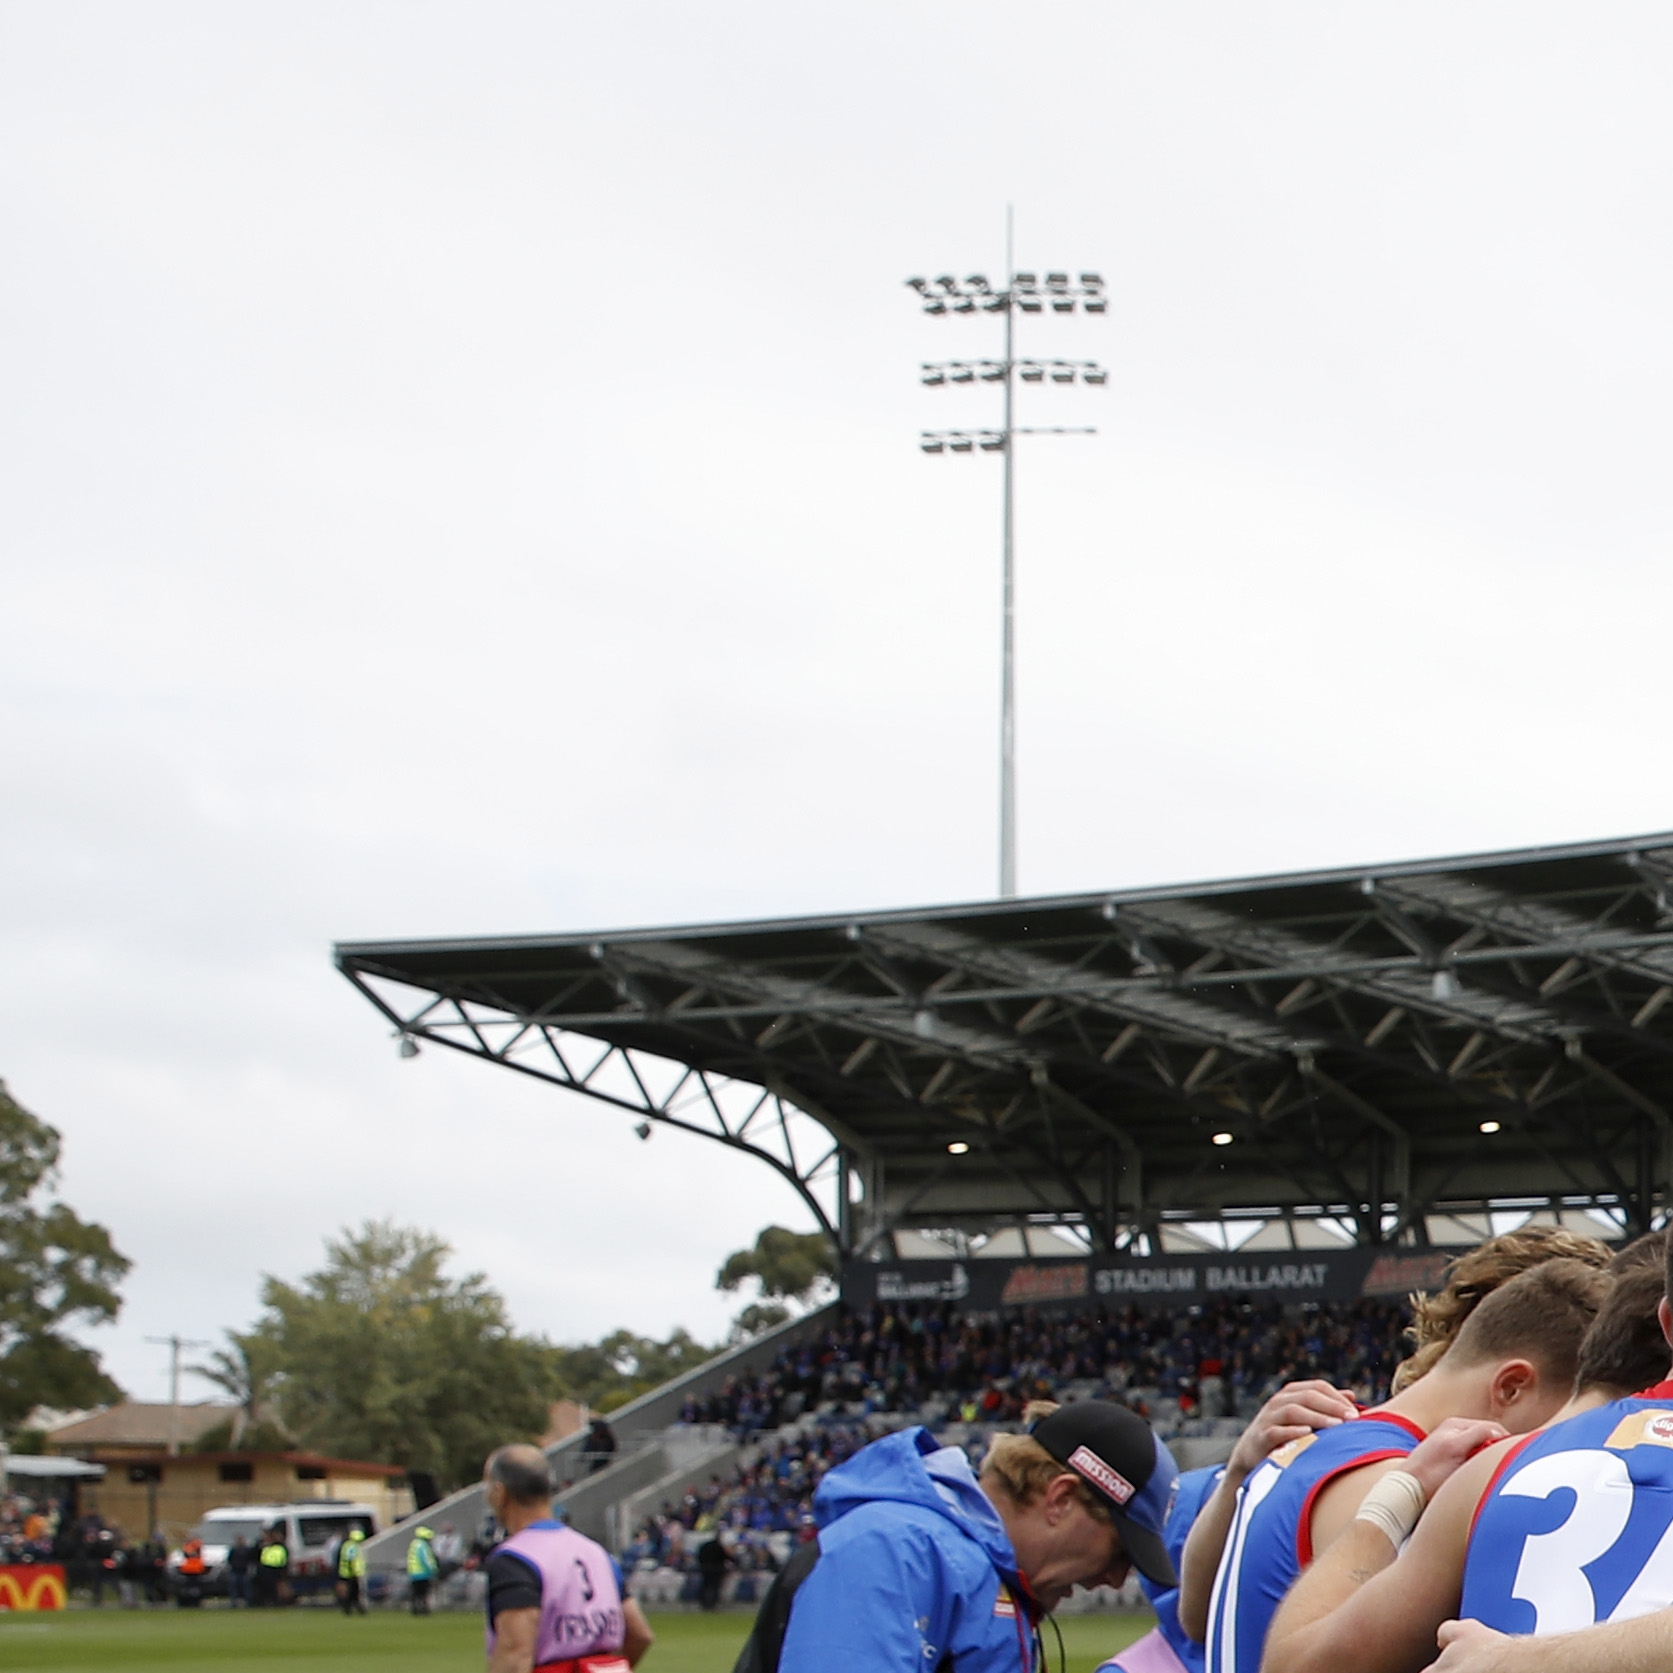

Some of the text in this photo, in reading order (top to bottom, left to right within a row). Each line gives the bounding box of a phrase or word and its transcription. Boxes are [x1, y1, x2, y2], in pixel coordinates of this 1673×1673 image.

[1095, 1267, 1196, 1293] STADIUM
[1205, 1264, 1328, 1291] BALLARAT
[1077, 1450, 1129, 1498] mission
